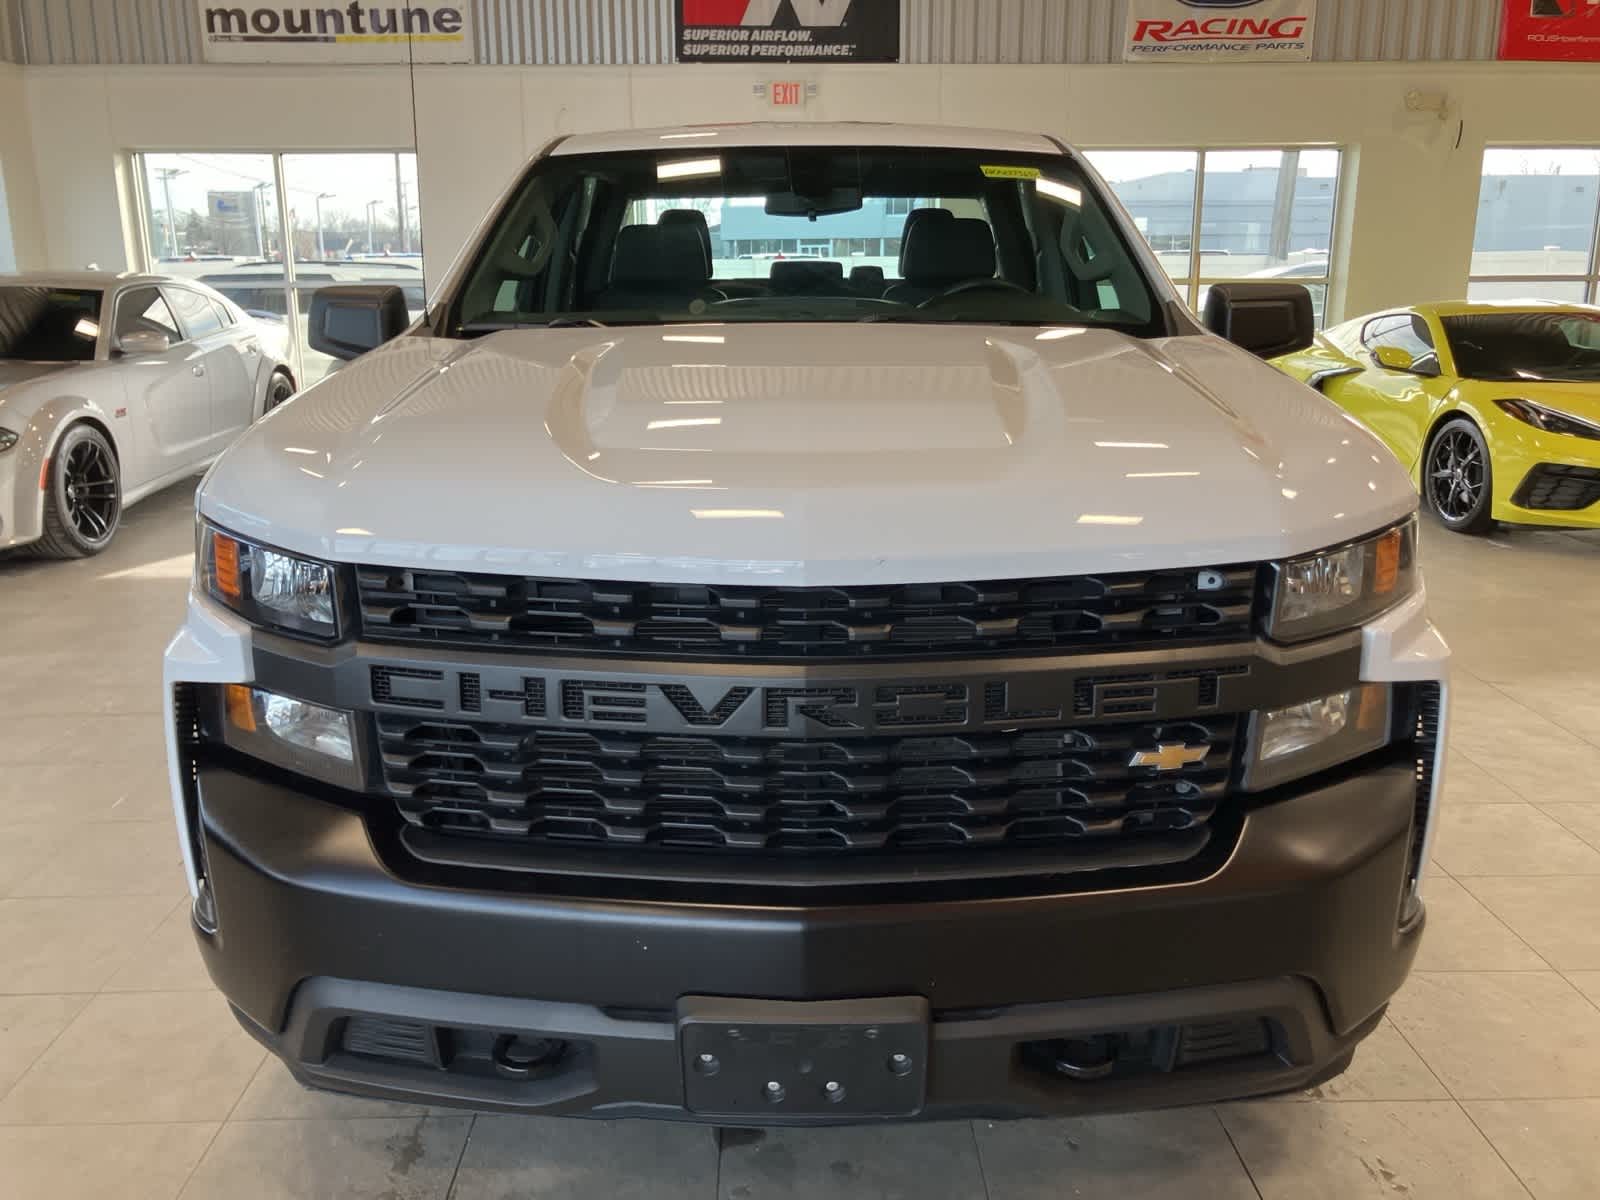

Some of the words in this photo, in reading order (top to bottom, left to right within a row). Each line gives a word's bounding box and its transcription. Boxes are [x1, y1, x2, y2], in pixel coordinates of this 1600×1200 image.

[206, 1, 463, 34] mountune
[683, 29, 748, 41] SUPERIOR
[751, 30, 812, 42] AIRFLOW.
[1133, 17, 1307, 42] RACING
[683, 44, 749, 56] SUPERIOR
[1131, 43, 1249, 52] PERFORMANCE
[1255, 42, 1305, 50] PARTS
[773, 83, 800, 105] EXIT
[370, 664, 1250, 730] CHEVROLET
